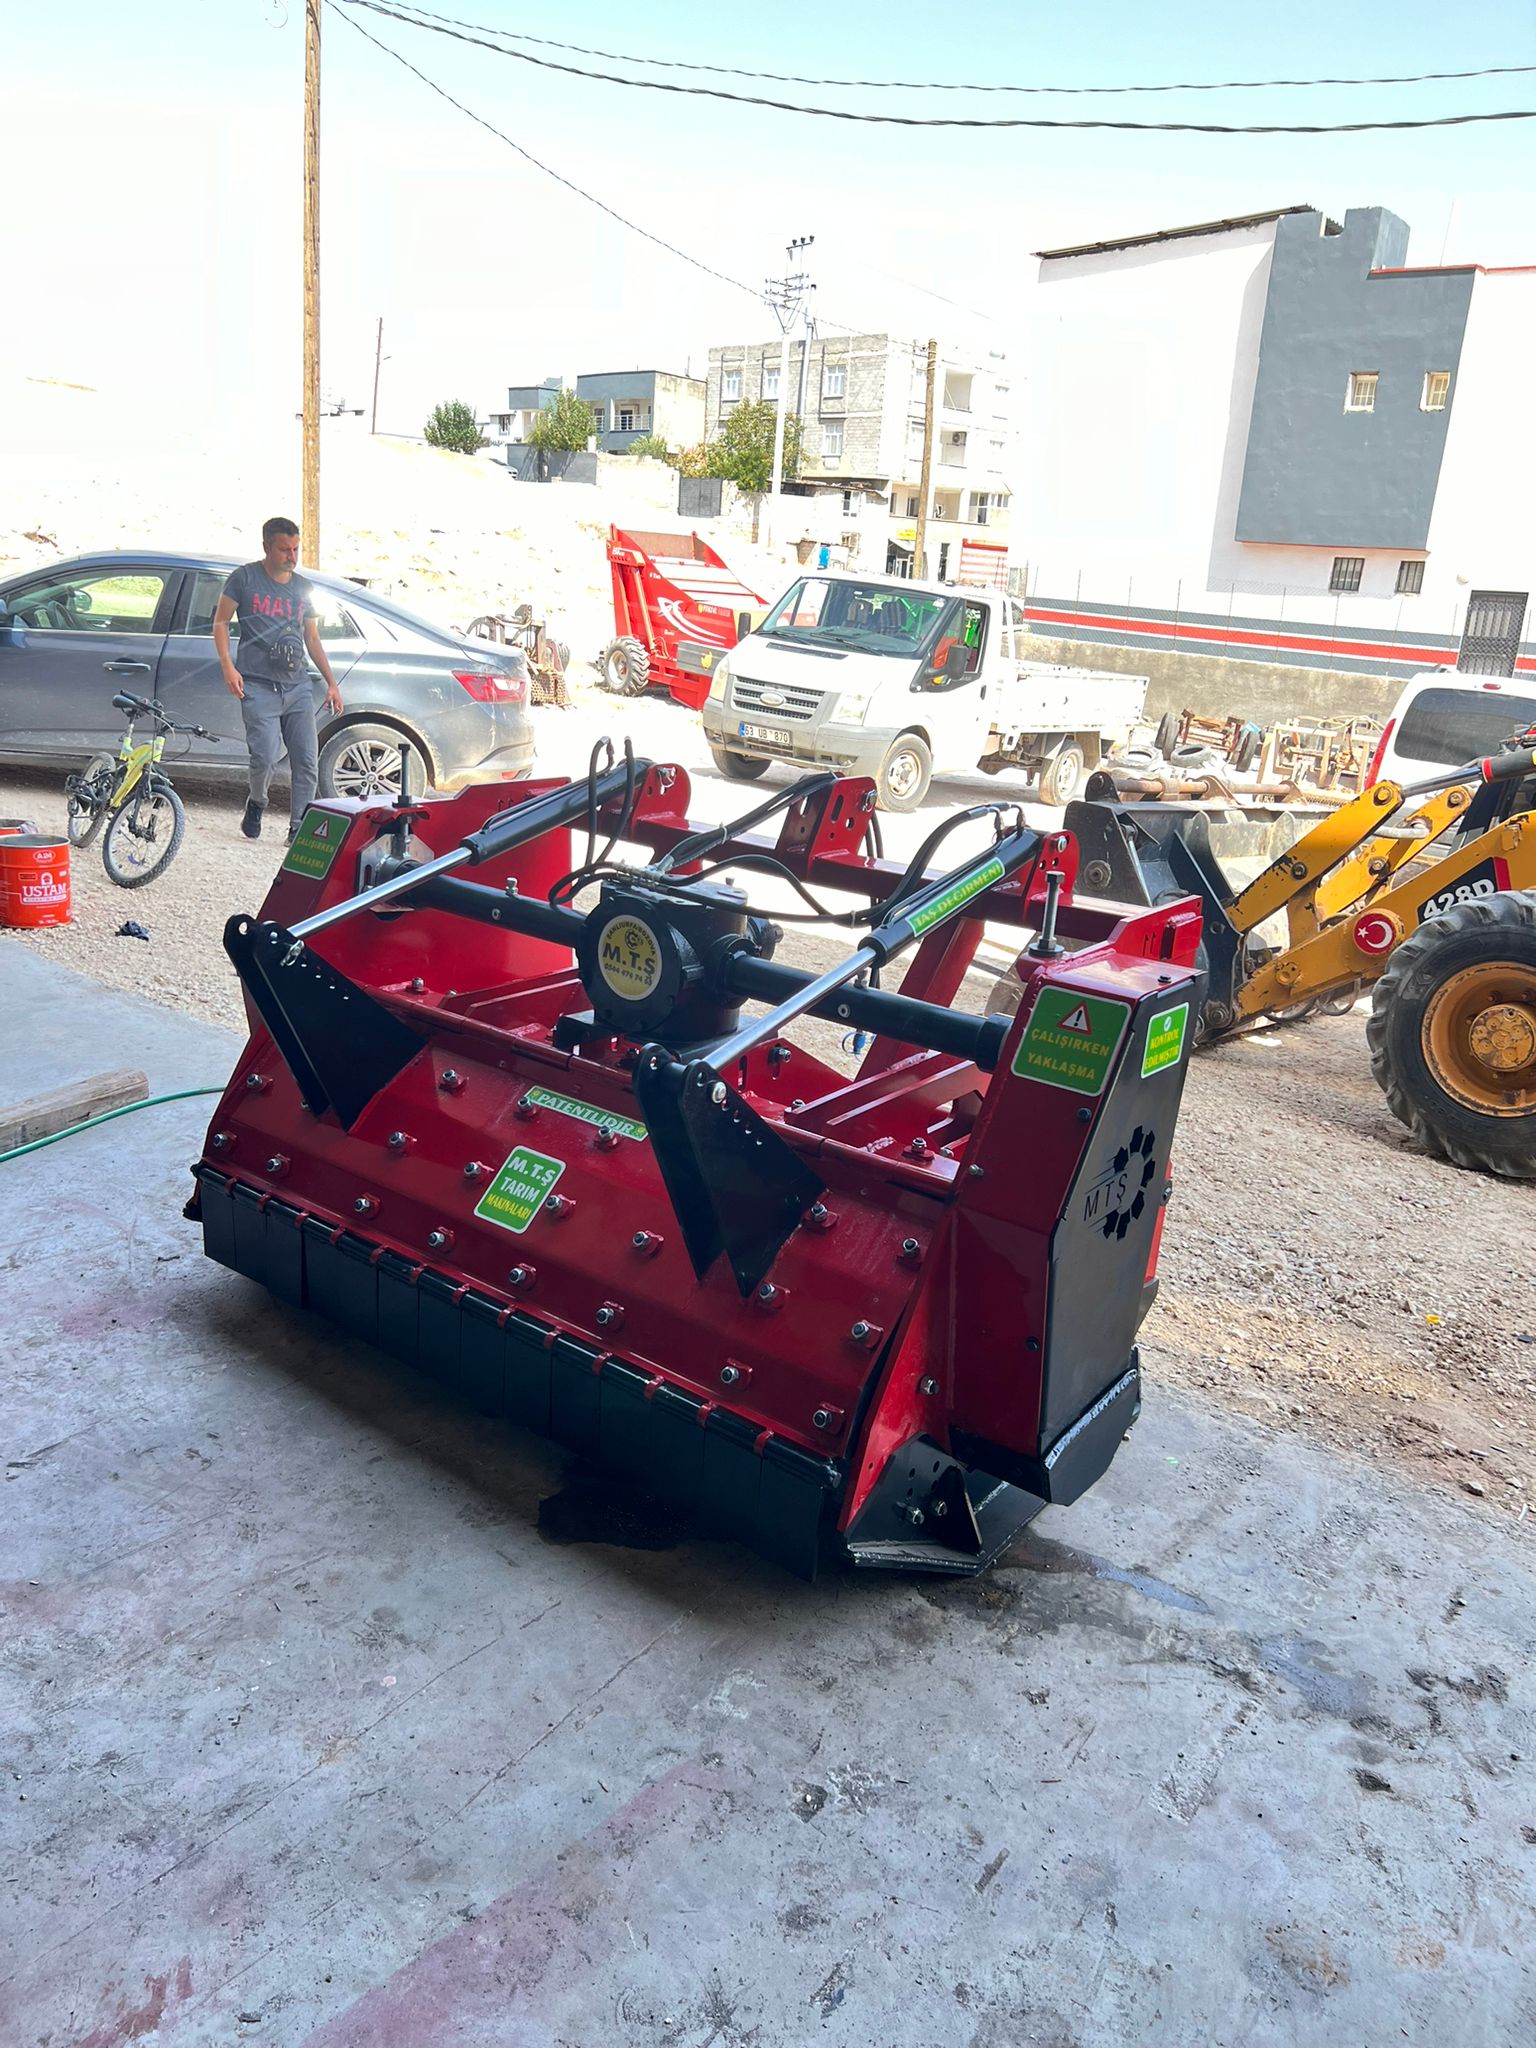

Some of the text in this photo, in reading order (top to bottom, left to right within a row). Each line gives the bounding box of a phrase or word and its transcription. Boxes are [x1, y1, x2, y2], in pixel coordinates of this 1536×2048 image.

[744, 725, 788, 743] 63 UB 870
[1423, 879, 1495, 919] 428D
[1030, 1028, 1110, 1057] ÇALIŞIRKEN
[1027, 1052, 1095, 1080] YAKLAŞMA
[537, 1093, 635, 1134] PATENTLİDİR
[508, 1156, 556, 1187] M.T.Ş
[500, 1177, 540, 1203] TARIM
